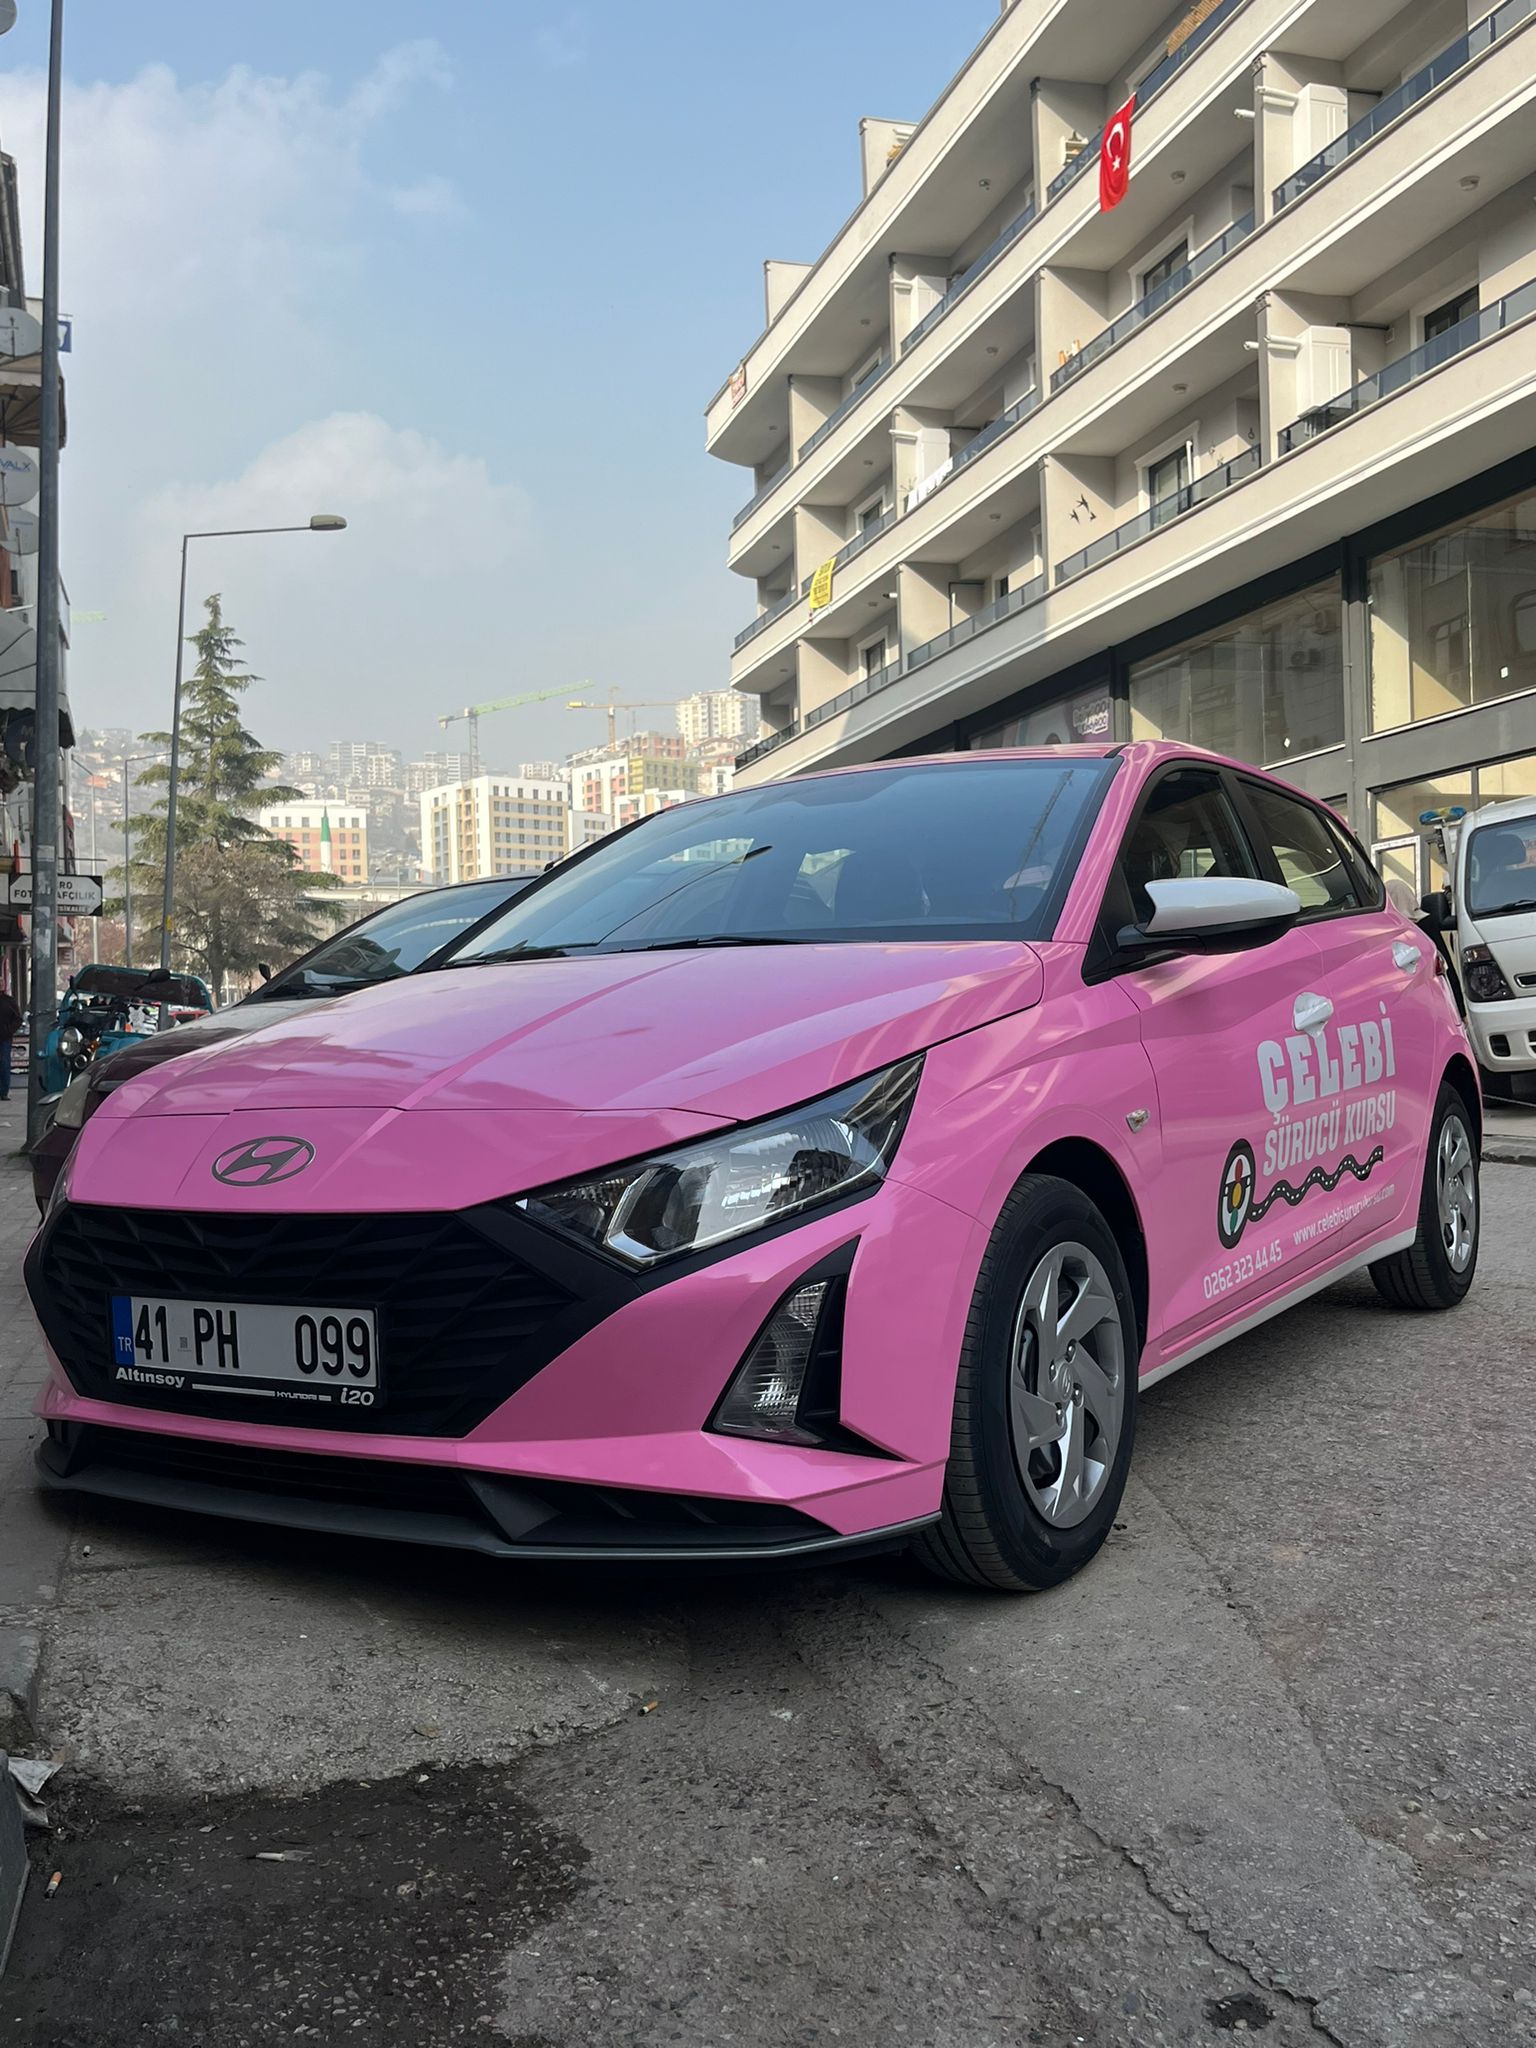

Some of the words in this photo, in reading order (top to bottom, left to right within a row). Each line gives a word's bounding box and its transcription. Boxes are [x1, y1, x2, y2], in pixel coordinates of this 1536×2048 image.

[14, 889, 95, 900] FOTAFÇILIK
[1257, 1000, 1396, 1125] ÇELEBİ
[1343, 1090, 1396, 1146] KURSU
[1203, 1265, 1233, 1299] 0262
[1233, 1254, 1254, 1284] 323
[1255, 1247, 1269, 1271] 44
[1270, 1239, 1283, 1263] 45
[117, 1336, 132, 1352] TR
[135, 1304, 169, 1363] 41
[193, 1308, 239, 1369] PH
[294, 1314, 371, 1378] 099
[340, 1387, 375, 1406] i20
